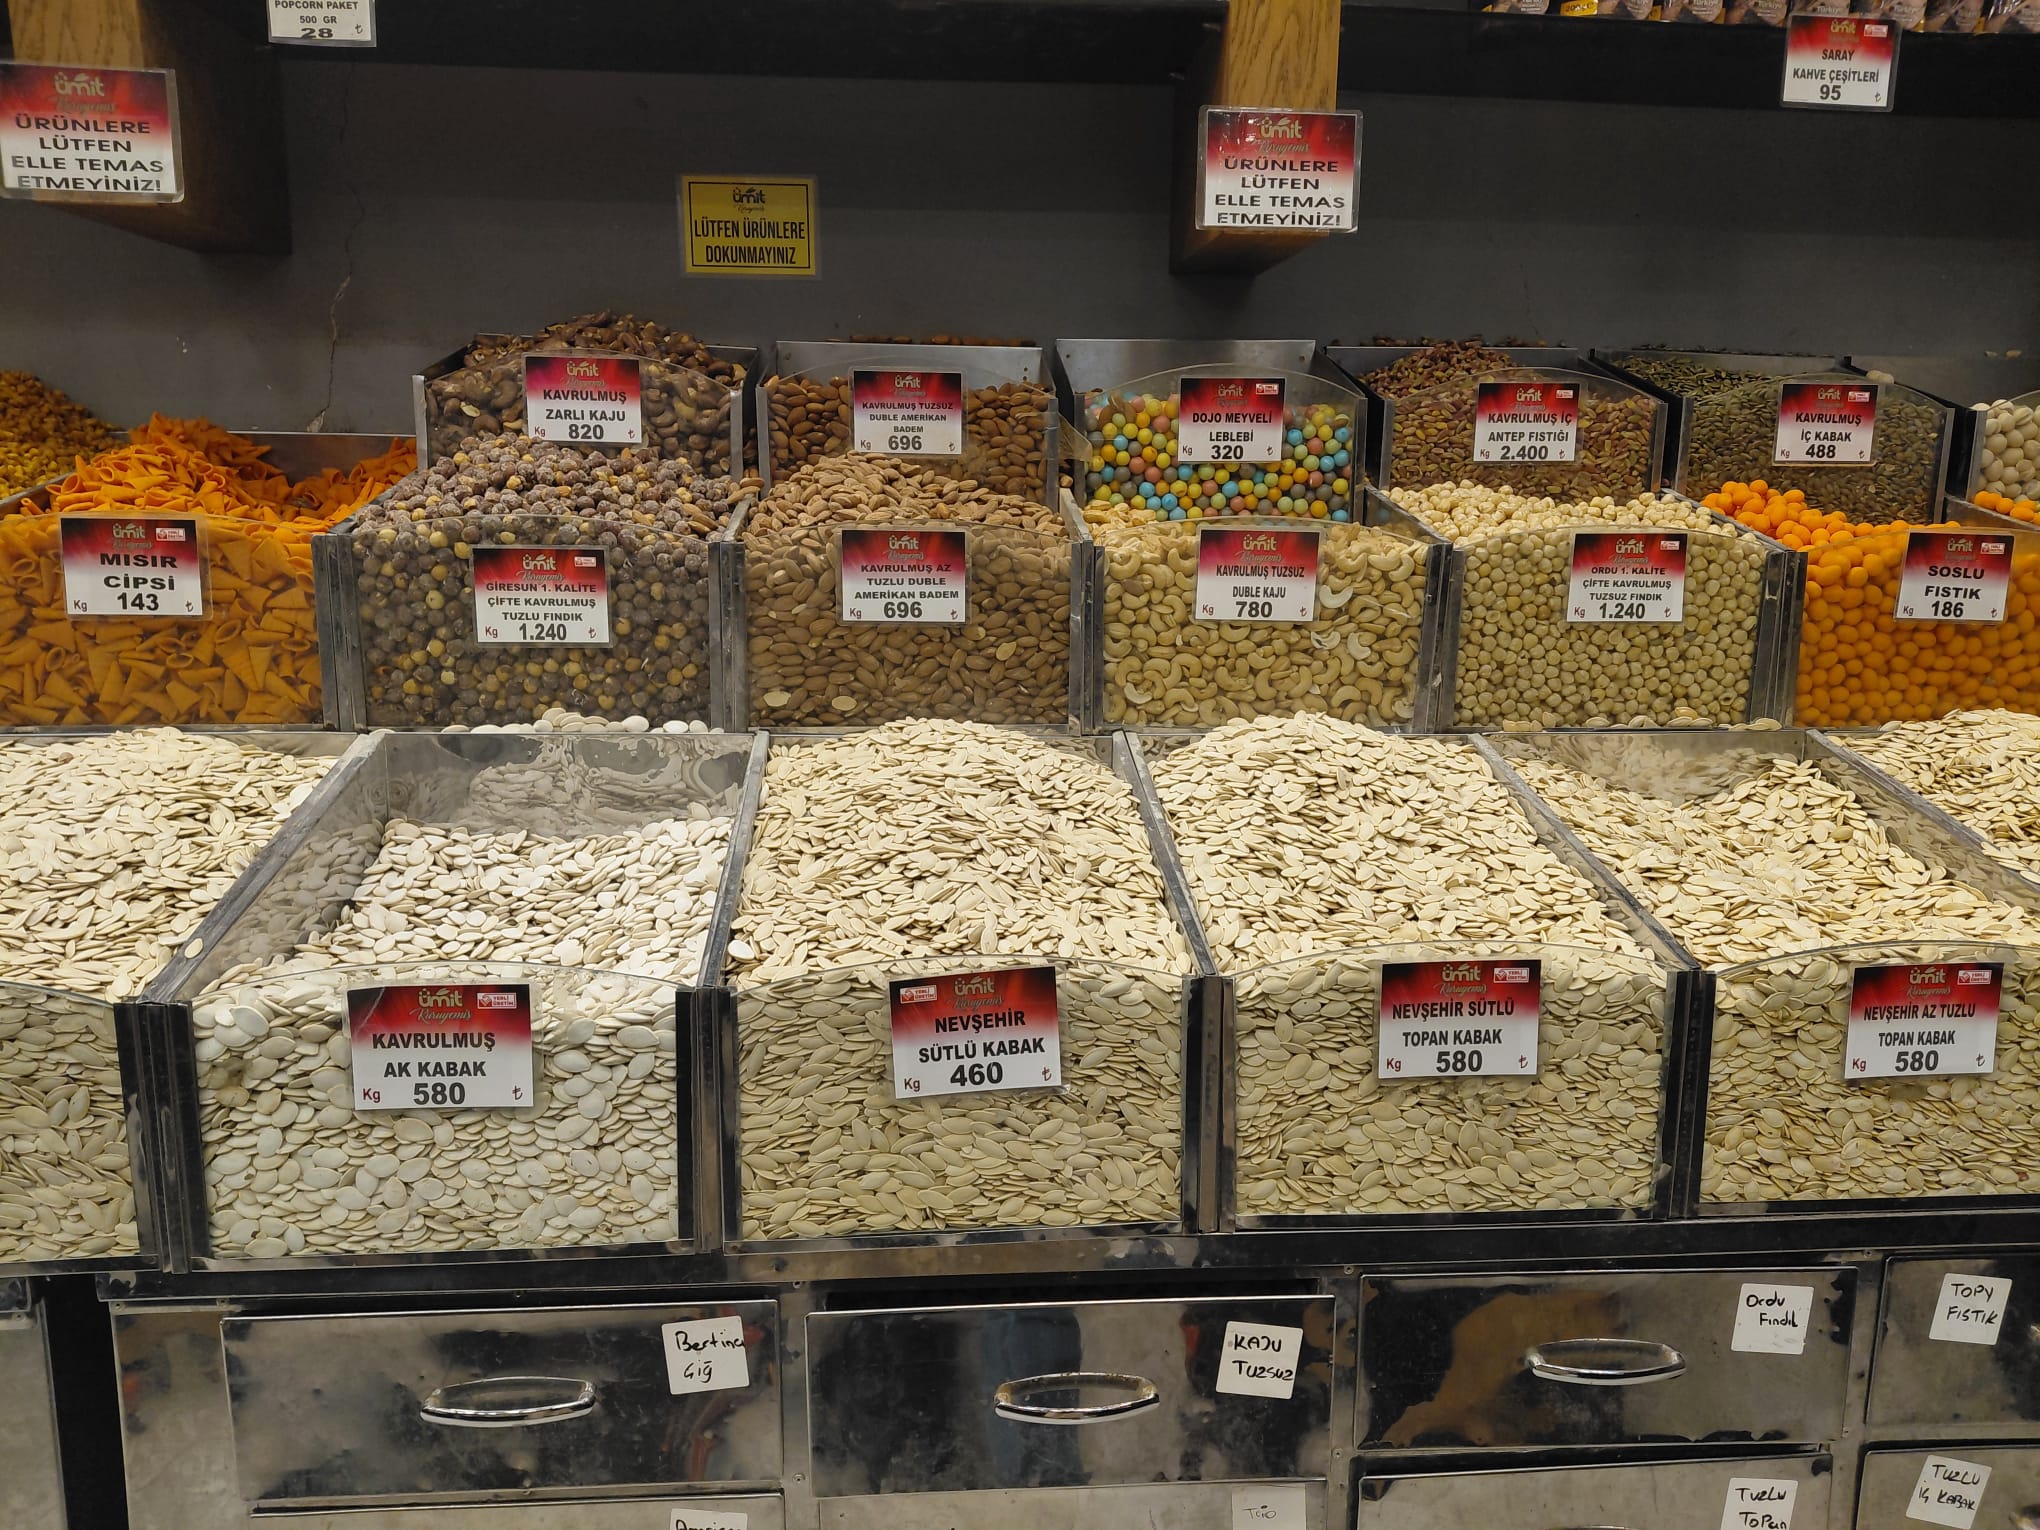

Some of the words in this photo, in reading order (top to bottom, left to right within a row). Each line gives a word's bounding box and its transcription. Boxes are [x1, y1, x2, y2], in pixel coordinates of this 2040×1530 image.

[327, 2, 358, 10] PAKET
[301, 28, 333, 38] 28
[1822, 49, 1855, 61] SARAY
[54, 71, 104, 96] ümit
[1793, 68, 1826, 80] KAHVE
[1829, 68, 1879, 84] ÇEŞİTLERİ
[1820, 84, 1841, 100] 95
[15, 113, 150, 133] ÜRÜNLERE
[1260, 117, 1302, 139] ümit
[39, 135, 131, 152] LÜTFEN
[12, 156, 66, 169] ELLE
[75, 158, 163, 172] TEMAS
[1225, 156, 1338, 172] ÜRÜNLERE
[18, 176, 161, 191] ETMEYİNİZ!
[1241, 174, 1319, 190] LÜTFEN
[1216, 194, 1261, 207] ELLE
[1269, 196, 1344, 208] TEMAS
[1218, 211, 1340, 226] ETMEYİNİZ!
[694, 216, 739, 238] LÜTFEN
[743, 217, 805, 239] ÜRÜNLERE
[706, 245, 796, 264] DOKUNMAYINIZ
[544, 389, 626, 404] KAVRULMUŞ
[862, 402, 916, 411] KAVRULMUŞ
[546, 409, 585, 420] ZARLI
[590, 410, 625, 421] KAJU
[901, 413, 946, 421] AMERİKAN
[1193, 413, 1221, 423] DOJO
[1225, 411, 1272, 423] MEYVELİ
[1488, 413, 1557, 425] KAVRULMUŞ
[1561, 411, 1572, 425] İÇ
[1796, 413, 1862, 426] KAVRULMUŞ
[534, 427, 545, 437] Kg
[569, 424, 604, 439] 820
[1210, 429, 1254, 441] LEBLEBİ
[1488, 432, 1525, 441] ANTEP
[1529, 430, 1568, 441] FISTIĞI
[1801, 429, 1811, 443] İÇ
[1815, 432, 1852, 442] KABAK
[861, 440, 871, 450] Kg
[888, 436, 922, 450] 696
[1183, 446, 1192, 455] Kg
[1211, 445, 1243, 459] 320
[1480, 449, 1490, 459] Kg
[1500, 446, 1548, 460] 2.400
[1781, 449, 1790, 458] Kg
[1806, 444, 1836, 458] 488
[101, 553, 178, 568] MISIR
[861, 564, 932, 574] KAVRULMUŞ
[936, 564, 951, 572] AZ
[1216, 565, 1268, 580] KAVRULMUŞ
[1272, 566, 1304, 577] TUZSUZ
[1632, 566, 1665, 574] KALİTE
[1928, 566, 1984, 579] SOSLU
[104, 574, 175, 590] CİPSİ
[487, 581, 537, 592] GİRESUN
[542, 584, 551, 592] 1.
[555, 583, 597, 592] KALİTE
[867, 578, 904, 586] TUZLU
[1583, 578, 1609, 588] ÇİFTE
[1613, 580, 1672, 590] KAVRULMUŞ
[855, 590, 915, 599] AMERİKAN
[1233, 586, 1260, 598] DUBLE
[1263, 587, 1286, 598] KAJU
[1630, 593, 1662, 601] FINDIK
[1925, 586, 1981, 600] FISTIK
[74, 600, 87, 612] Kg
[117, 592, 159, 611] 143
[488, 596, 520, 608] ÇİFTE
[525, 598, 596, 608] KAVRULMUŞ
[1903, 606, 1914, 616] Kg
[1932, 600, 1964, 618] 186
[502, 612, 539, 621] TUZLU
[544, 613, 583, 621] FINDIK
[850, 608, 862, 619] Kg
[884, 602, 922, 618] 696
[1202, 604, 1214, 615] Kg
[1236, 602, 1272, 618] 780
[1574, 607, 1585, 618] Kg
[1600, 603, 1645, 619] 1.240
[485, 626, 498, 638] Kg
[519, 623, 567, 640] 1.240
[1442, 964, 1481, 982] ümit
[1910, 967, 1946, 984] ümit
[954, 976, 994, 995] ümit
[418, 988, 463, 1007] ümit
[1393, 998, 1463, 1022] NEVŞEHİR
[1468, 998, 1515, 1016] SÜTLÜ
[1864, 1002, 1918, 1023] NEVŞEHİR
[1921, 1005, 1937, 1019] AZ
[1940, 1003, 1976, 1018] TUZLU
[935, 1008, 1026, 1033] NEVŞEHİR
[372, 1032, 496, 1051] KAVRULMUŞ
[1403, 1031, 1448, 1047] TOPAN
[1453, 1029, 1502, 1045] KABAK
[1879, 1032, 1915, 1047] TOPAN
[1917, 1030, 1956, 1045] KABAK
[919, 1040, 976, 1063] SÜTLÜ
[983, 1038, 1045, 1057] KABAK
[1387, 1058, 1401, 1072] Kg
[1436, 1050, 1482, 1073] 580
[1852, 1058, 1866, 1071] Kg
[1895, 1050, 1939, 1072] 580
[384, 1062, 411, 1077] AK
[418, 1061, 486, 1077] KABAK
[904, 1078, 920, 1092] Kg
[950, 1062, 1003, 1086] 460
[363, 1088, 380, 1103] Kg
[414, 1083, 465, 1105] 580
[1951, 1284, 1994, 1303] TOPY
